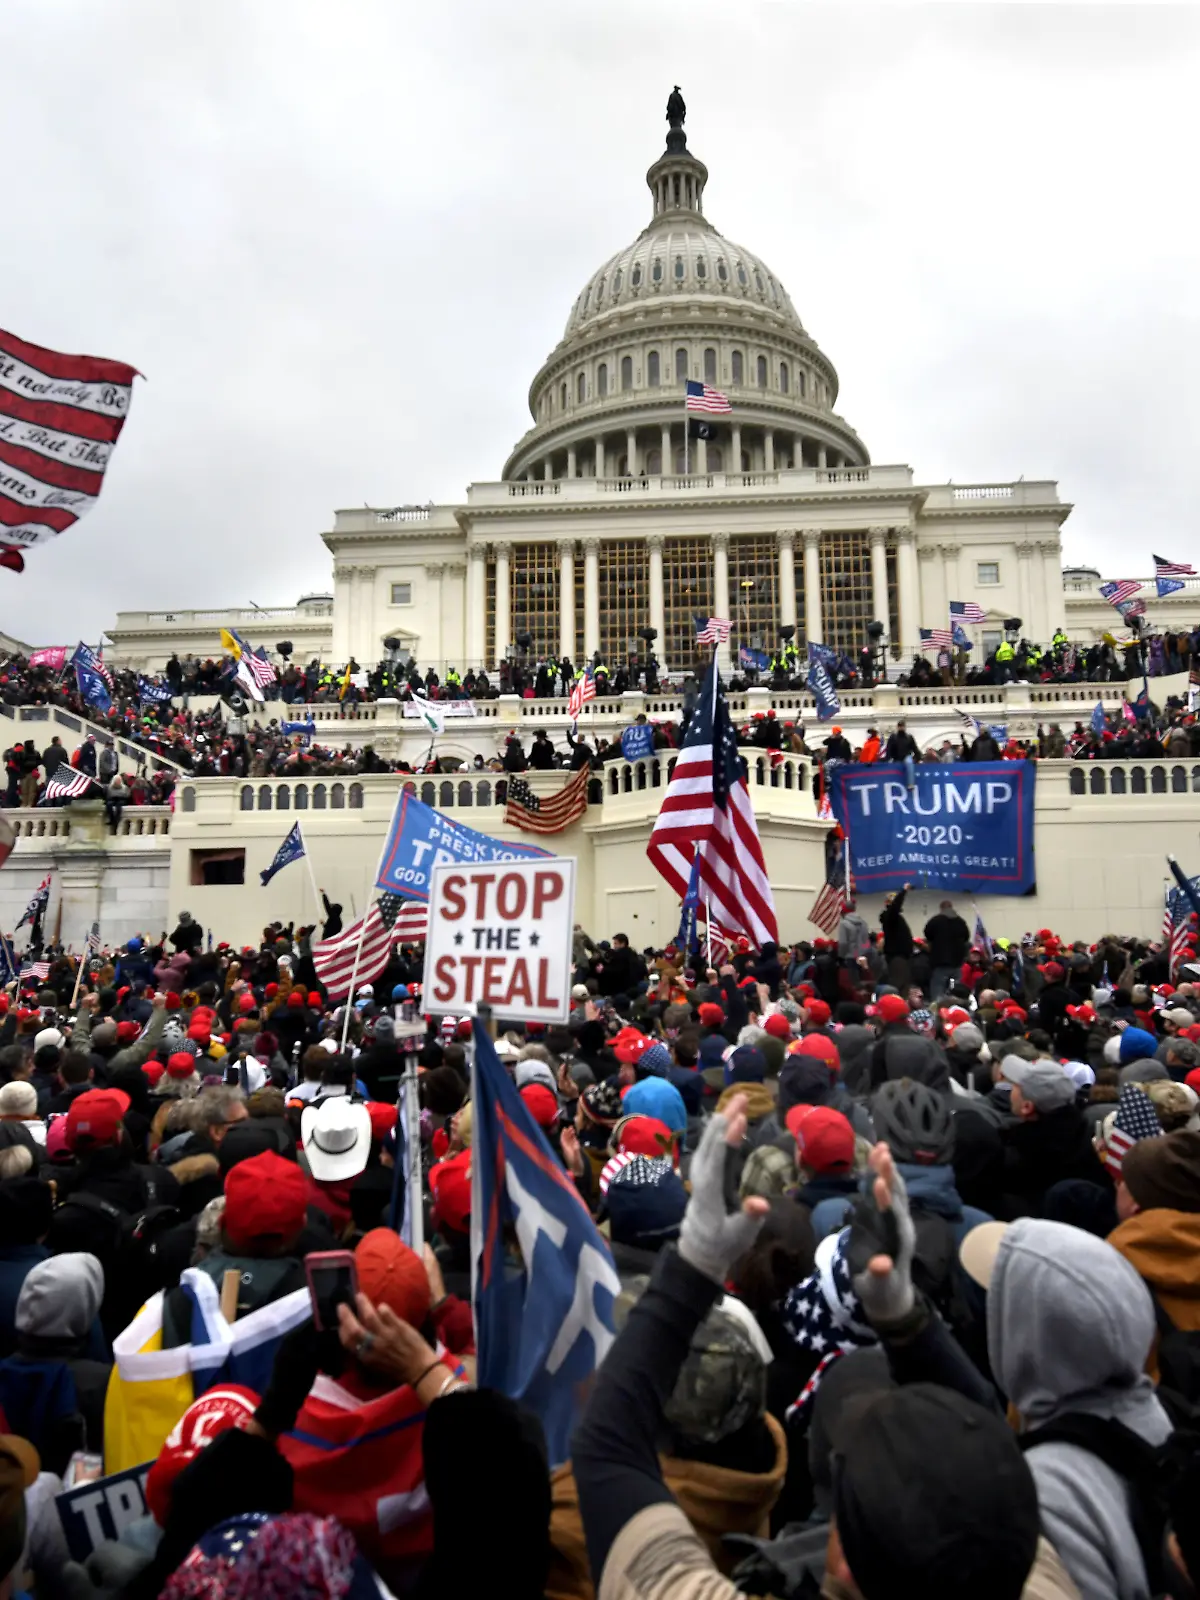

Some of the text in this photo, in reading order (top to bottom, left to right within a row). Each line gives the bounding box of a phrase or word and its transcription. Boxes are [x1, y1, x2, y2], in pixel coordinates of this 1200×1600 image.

[17, 375, 53, 394] not
[97, 385, 125, 408] Be
[20, 429, 67, 453] But
[851, 781, 1012, 816] TRUMP
[857, 853, 1015, 868] KEEP AMERICA GREAT!
[394, 867, 425, 885] GOD
[440, 871, 564, 921] STOP
[472, 928, 522, 951] THE
[433, 955, 560, 1008] STEAL
